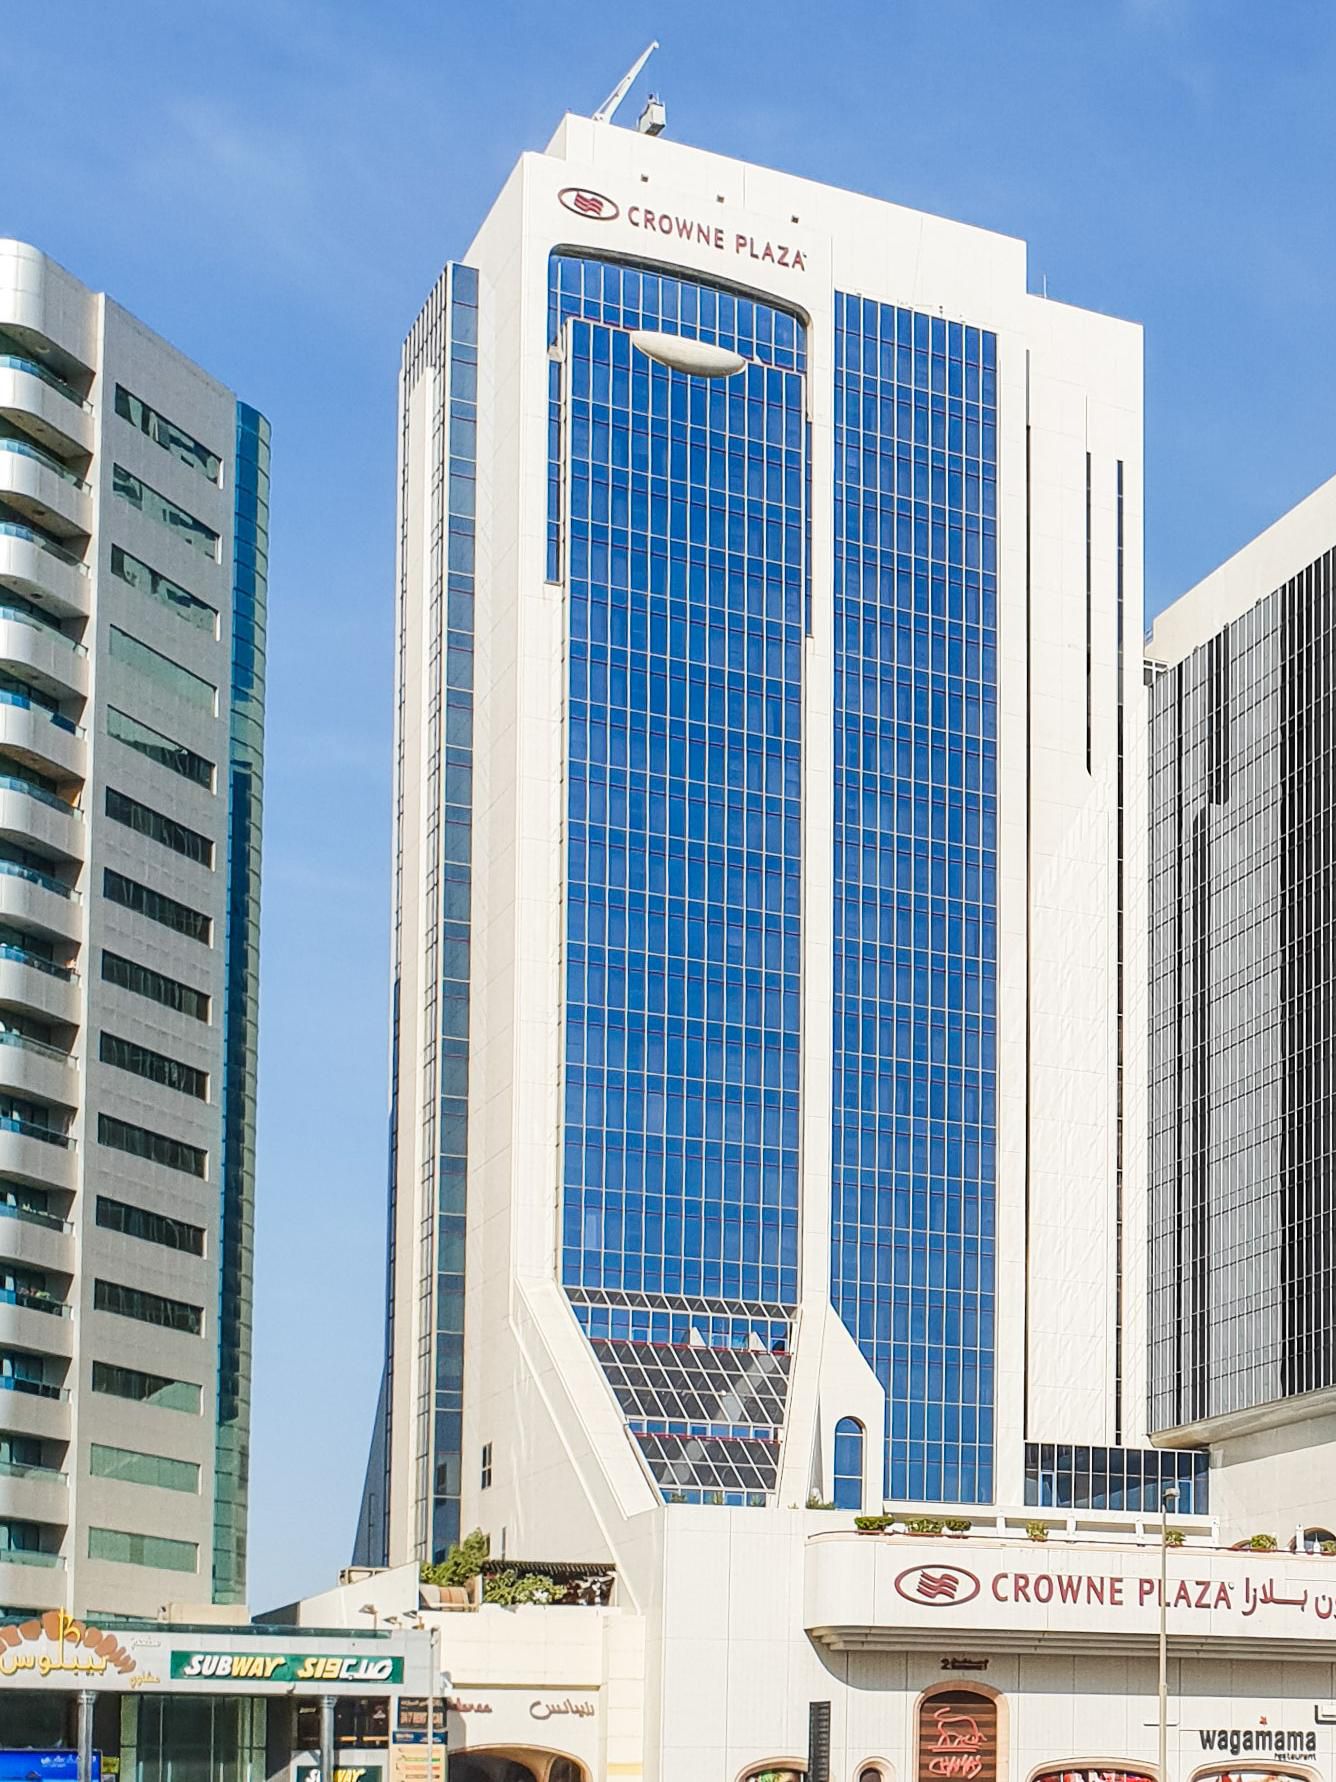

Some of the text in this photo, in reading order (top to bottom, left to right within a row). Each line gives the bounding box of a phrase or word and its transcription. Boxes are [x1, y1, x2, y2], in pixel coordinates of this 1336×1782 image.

[627, 206, 806, 271] CROWNE PLAZA
[991, 1572, 1232, 1610] CROWNE PLAZA
[1241, 1577, 1308, 1616] بلازا
[184, 1655, 286, 1679] SUBWAY
[1200, 1730, 1316, 1755] wagamama
